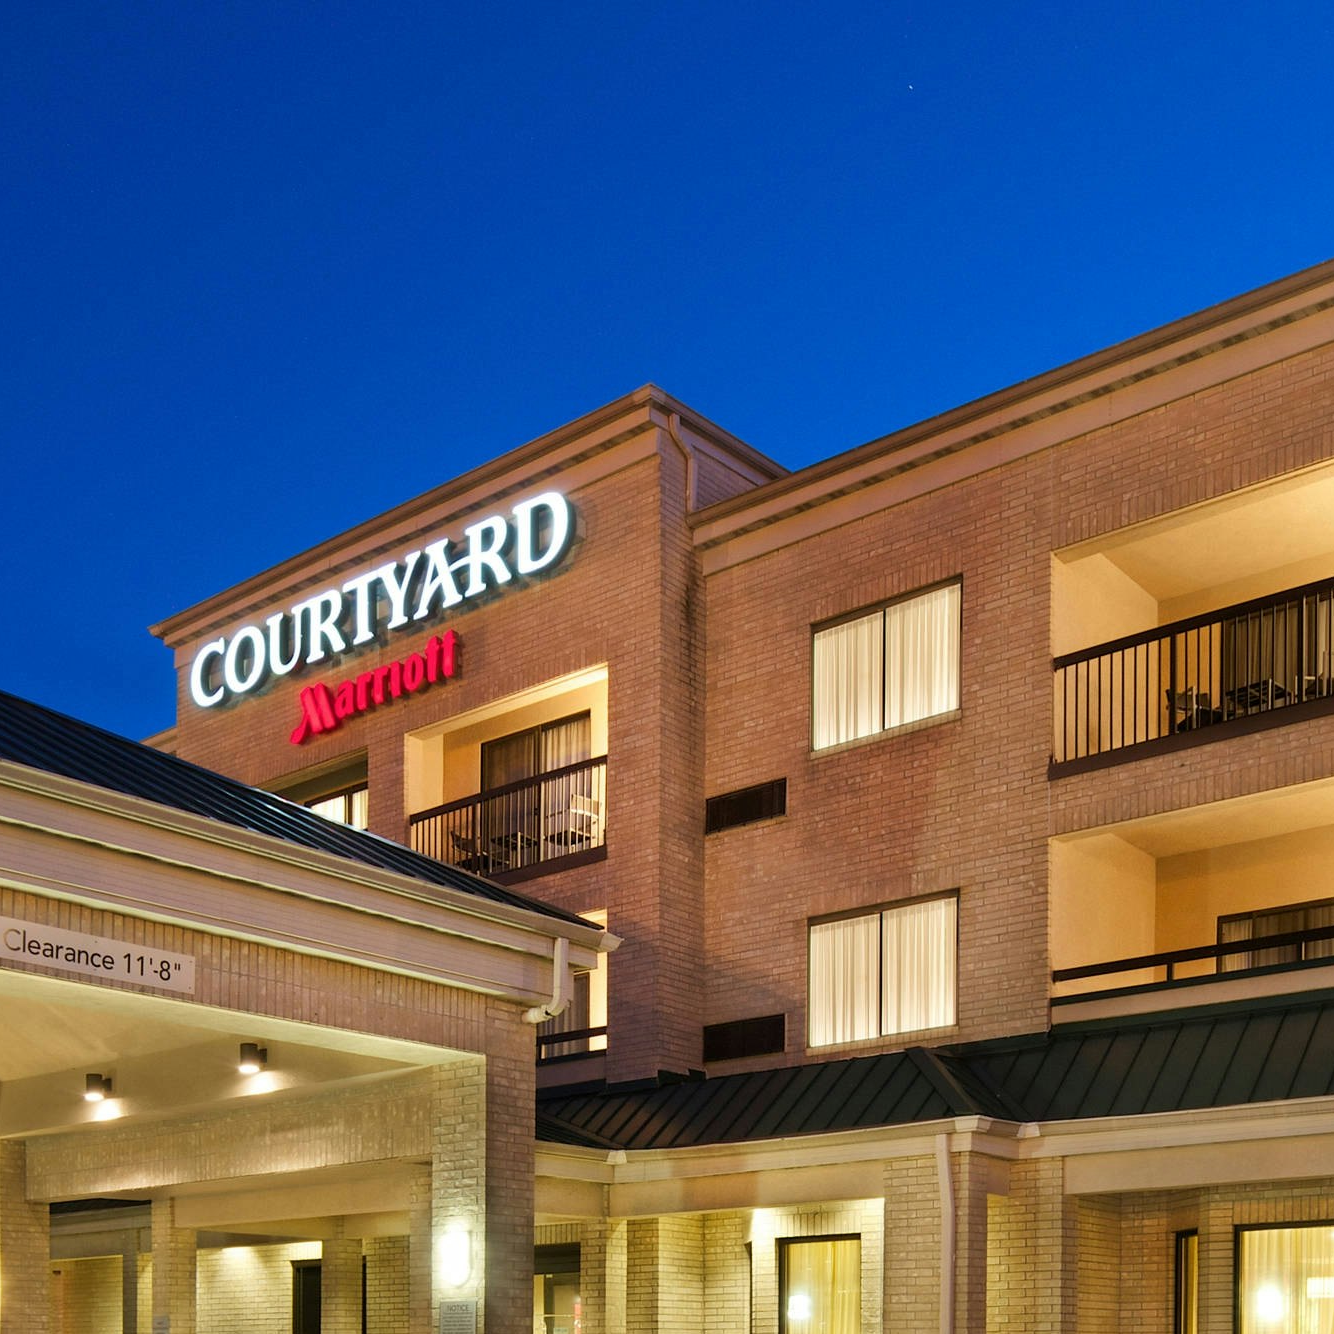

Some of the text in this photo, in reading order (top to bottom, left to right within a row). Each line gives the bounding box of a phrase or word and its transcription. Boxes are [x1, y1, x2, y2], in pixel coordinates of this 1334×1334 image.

[190, 491, 570, 707] COURTYARD
[289, 629, 461, 745] Marriott
[3, 928, 115, 970] Clearance
